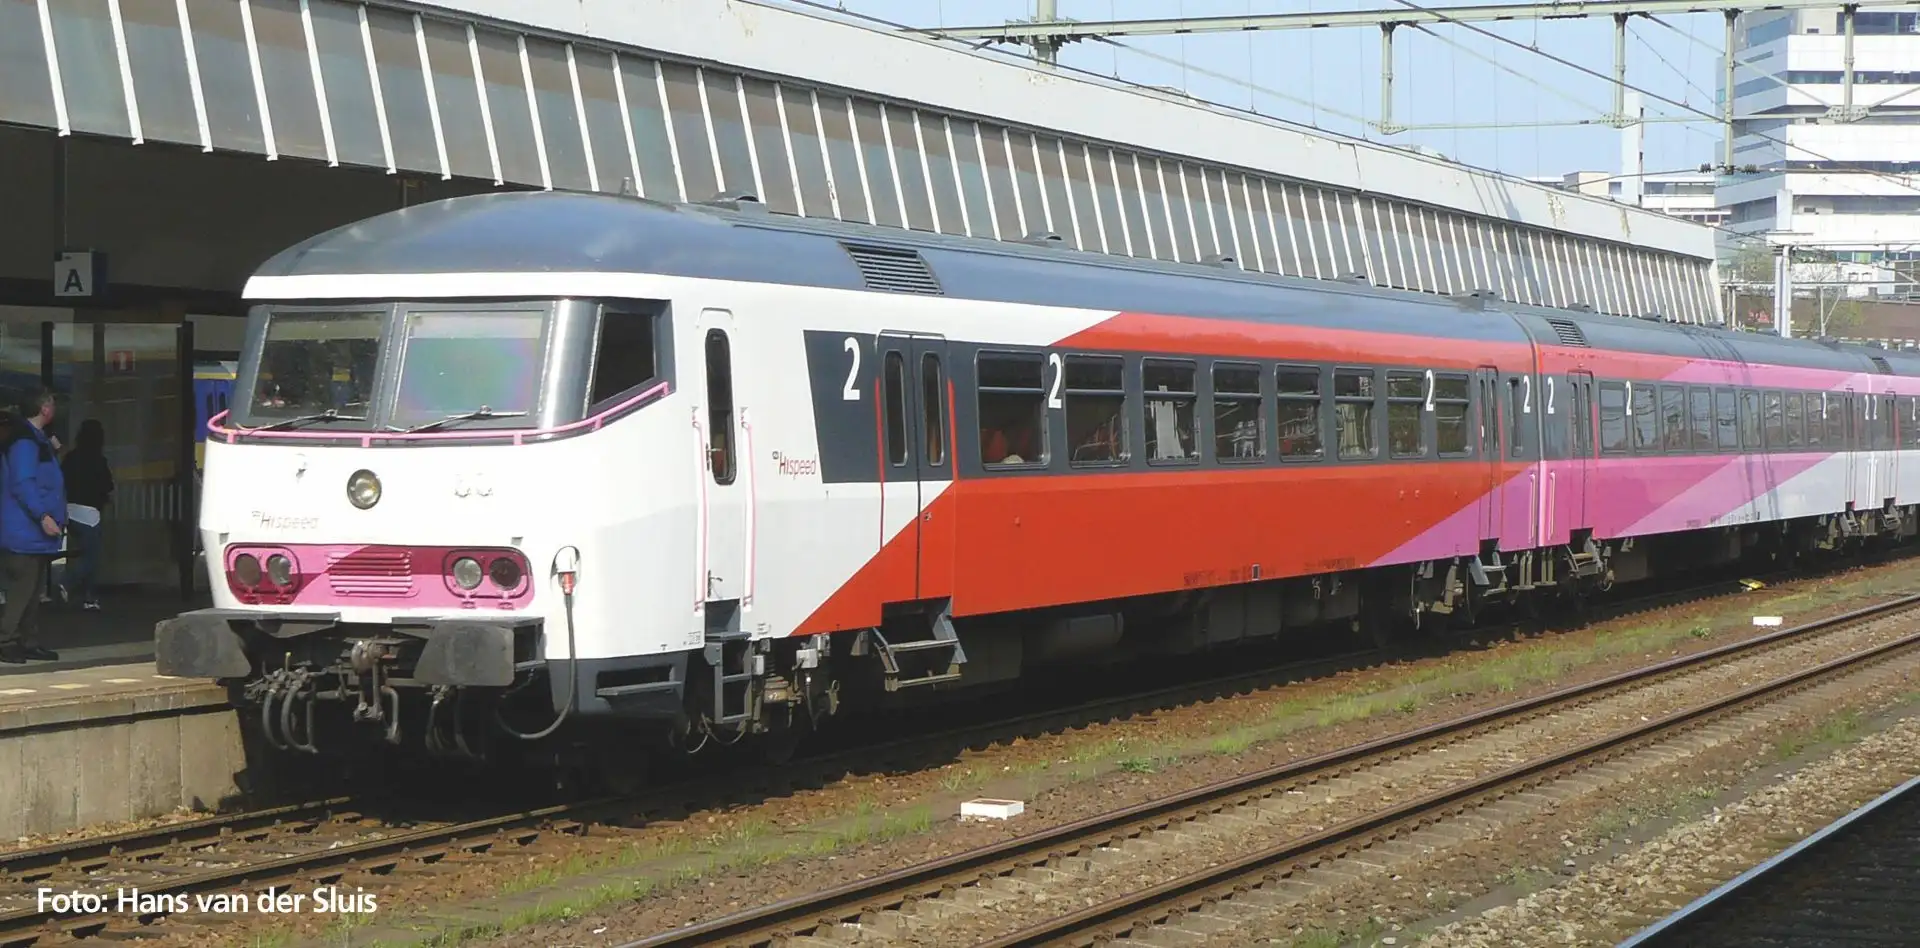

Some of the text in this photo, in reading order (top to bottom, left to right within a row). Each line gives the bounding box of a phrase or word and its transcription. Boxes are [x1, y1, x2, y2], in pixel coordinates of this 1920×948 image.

[64, 268, 84, 292] A
[843, 336, 860, 400] 2
[1048, 352, 1062, 409] 2
[1425, 368, 1434, 411] 2
[1523, 374, 1531, 413] 2
[1547, 375, 1555, 414] 2
[1625, 379, 1632, 416] 2
